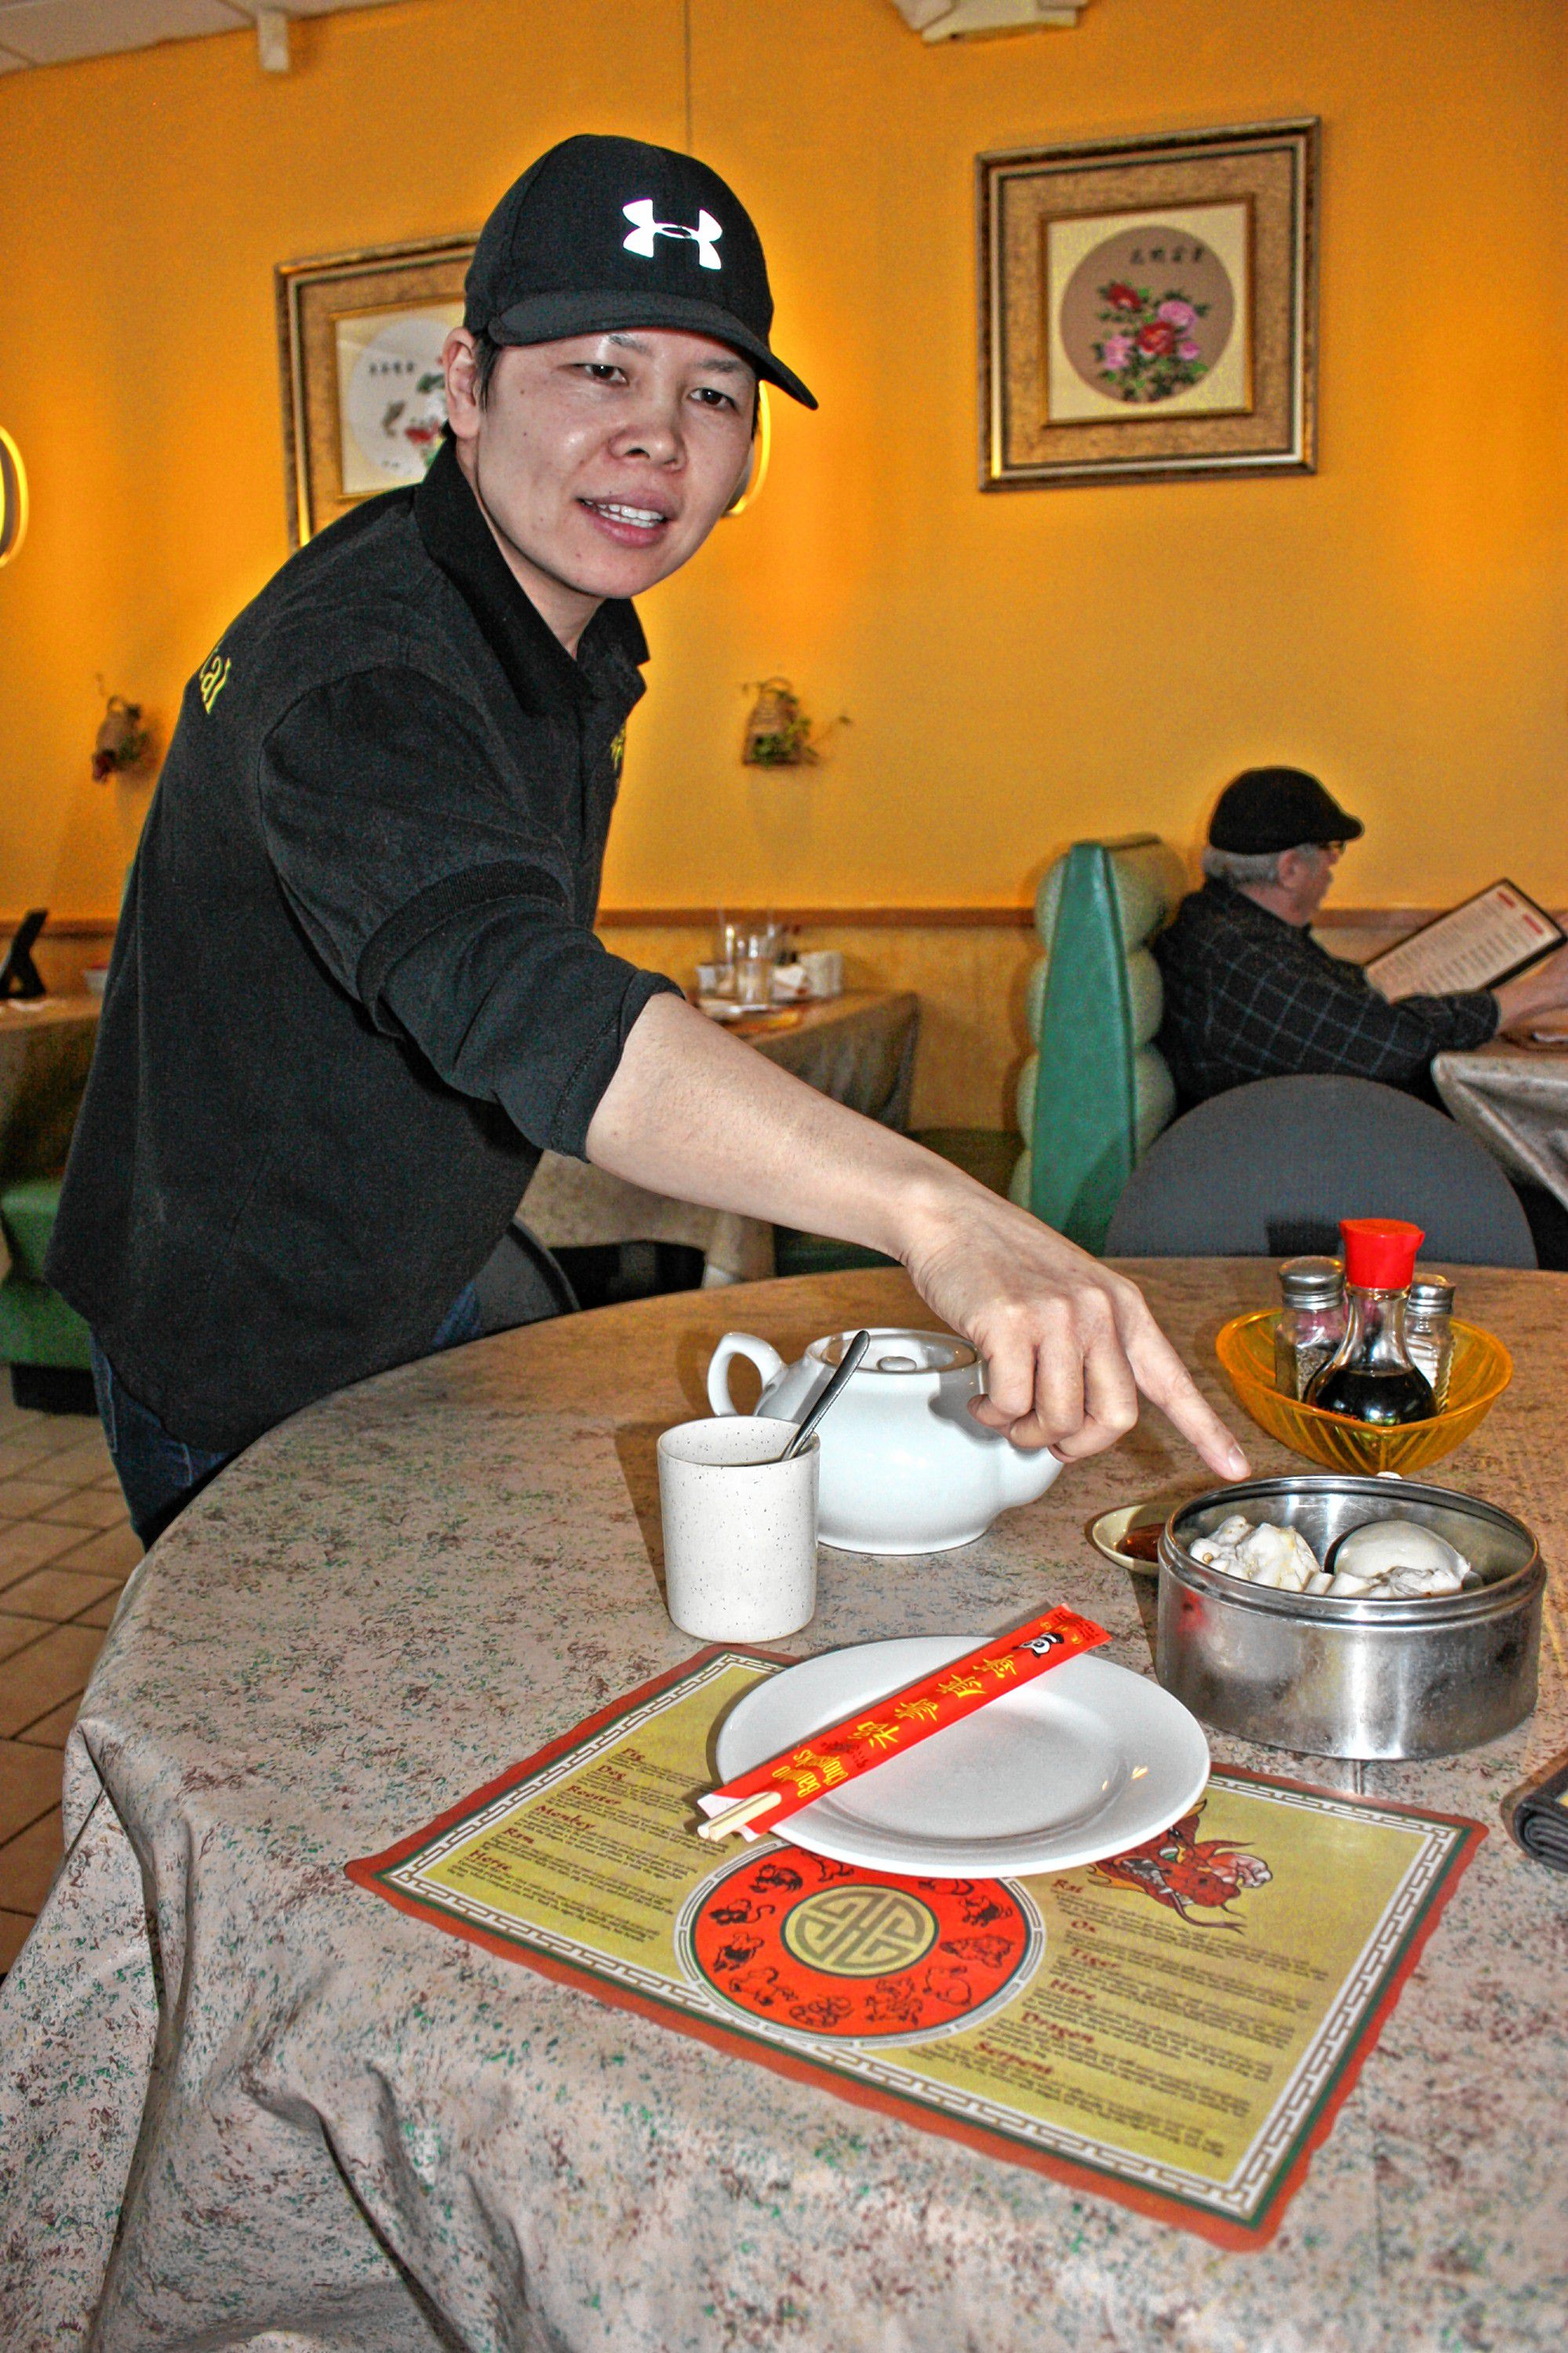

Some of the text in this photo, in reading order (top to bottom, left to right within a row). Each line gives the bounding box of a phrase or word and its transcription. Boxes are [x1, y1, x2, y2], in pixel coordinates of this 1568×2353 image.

[620, 1747, 646, 1762] Pig
[597, 1765, 627, 1780] Dog
[793, 1749, 849, 1786] Chopks
[772, 1766, 821, 1798] Bao
[566, 1785, 621, 1805] Rooster
[536, 1805, 595, 1831] Monkey
[504, 1827, 534, 1844] Ram
[468, 1849, 511, 1871] Horse
[1051, 1878, 1084, 1893] Rat
[1071, 1921, 1097, 1933] Ox
[1071, 1948, 1119, 1967] Tiger
[1050, 1979, 1096, 2000] Hare
[1021, 2011, 1095, 2044] Dragon
[973, 2041, 1053, 2075] Serpent
